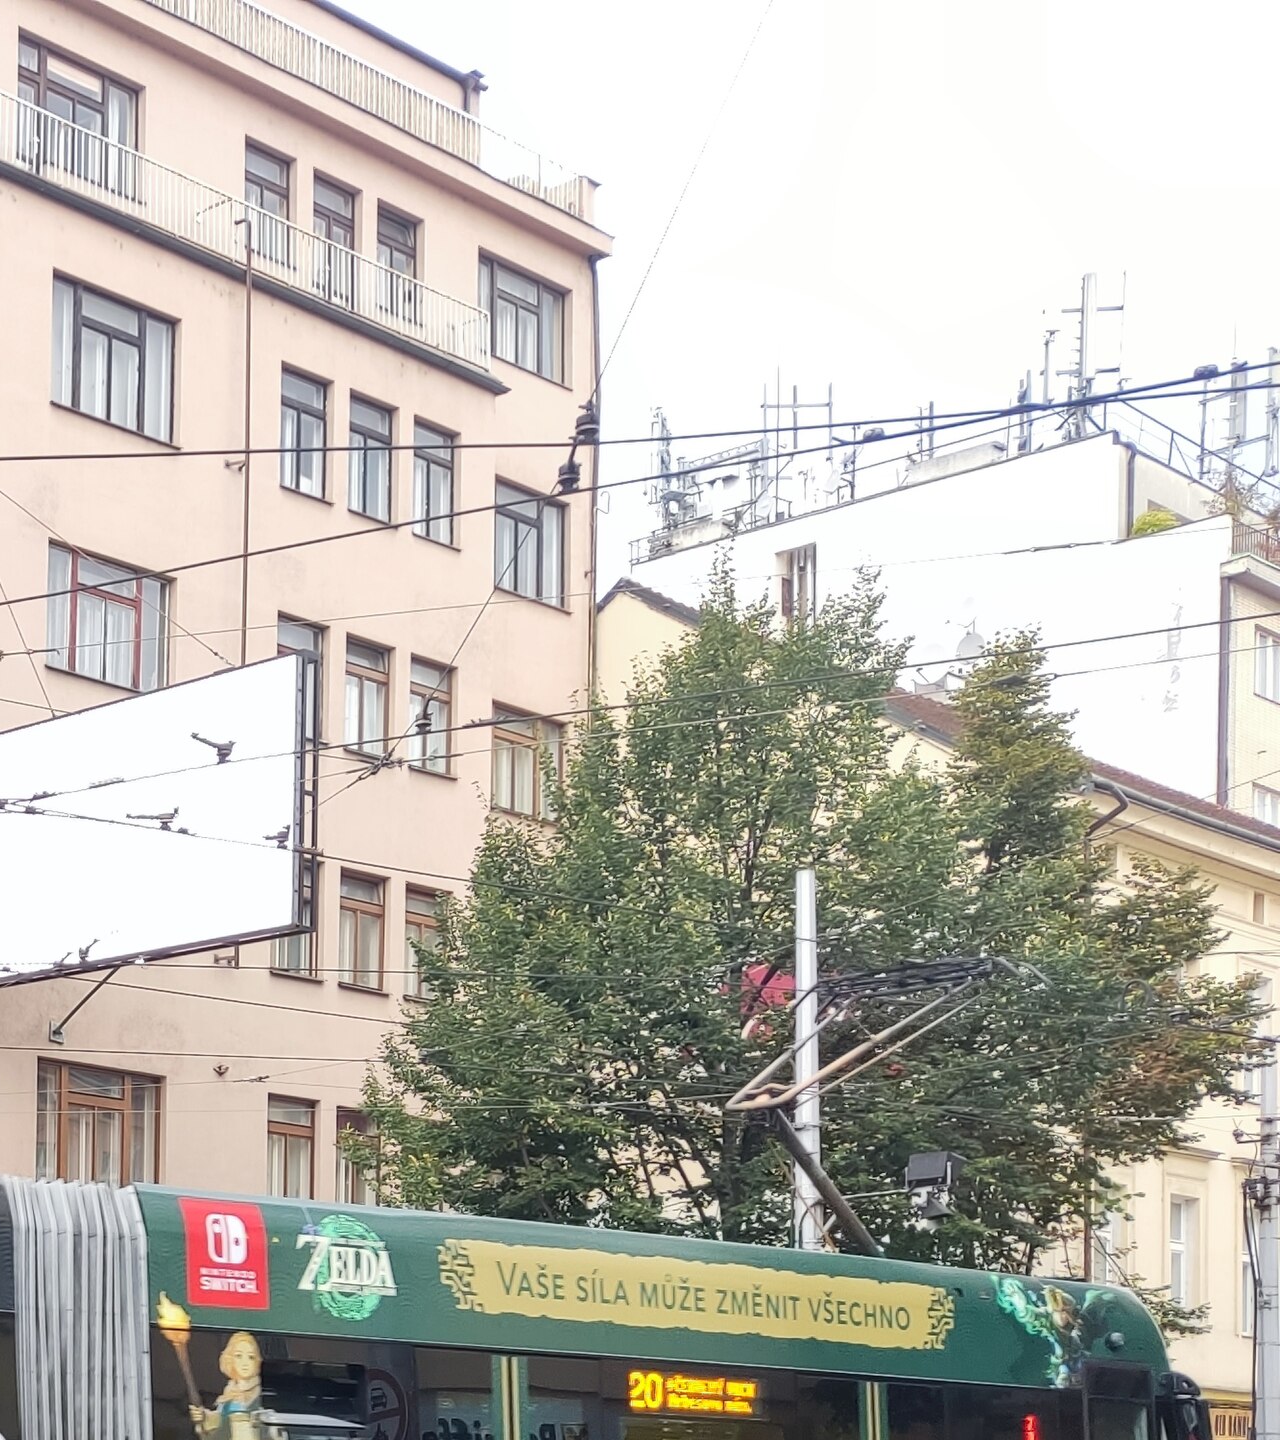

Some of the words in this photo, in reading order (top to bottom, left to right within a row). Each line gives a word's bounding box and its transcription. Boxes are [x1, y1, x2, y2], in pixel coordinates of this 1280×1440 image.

[295, 1234, 398, 1296] ZELDA
[495, 1260, 566, 1300] VAŠE
[576, 1268, 630, 1306] SÍLA
[640, 1273, 706, 1313] MŮŽE
[715, 1283, 801, 1321] ZMĚNIT
[807, 1291, 911, 1331] VŠECHNO
[628, 1371, 663, 1408] 20
